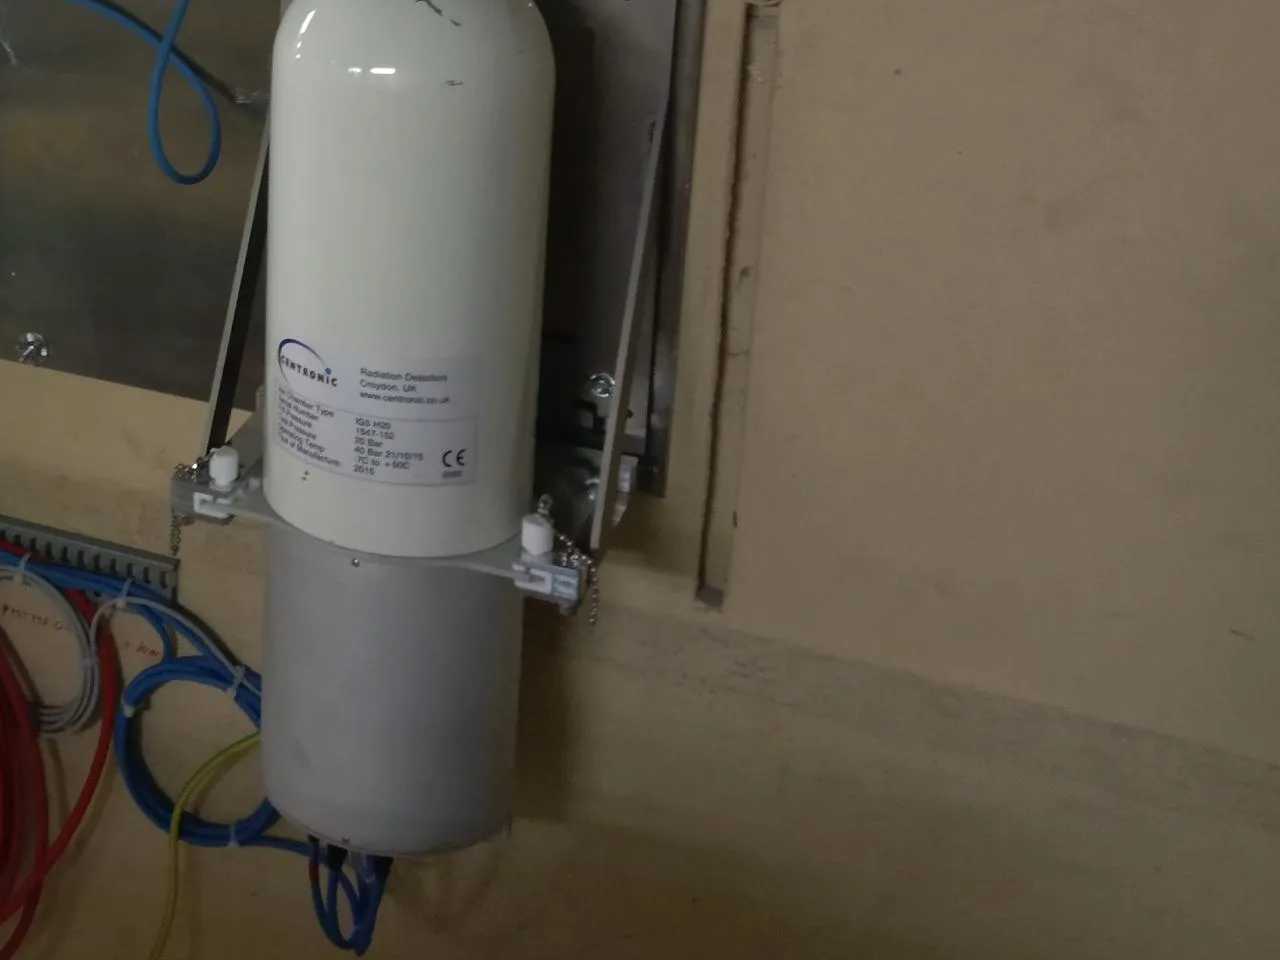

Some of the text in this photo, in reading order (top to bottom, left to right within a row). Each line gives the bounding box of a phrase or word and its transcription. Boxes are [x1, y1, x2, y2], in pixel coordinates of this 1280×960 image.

[279, 355, 338, 387] CENTRONIC
[360, 367, 402, 382] Radiation
[402, 384, 417, 393] UK
[316, 404, 335, 418] Type
[367, 438, 383, 447] Bar
[367, 447, 383, 457] Bar
[441, 448, 466, 468] CE
[353, 464, 375, 476] 2015
